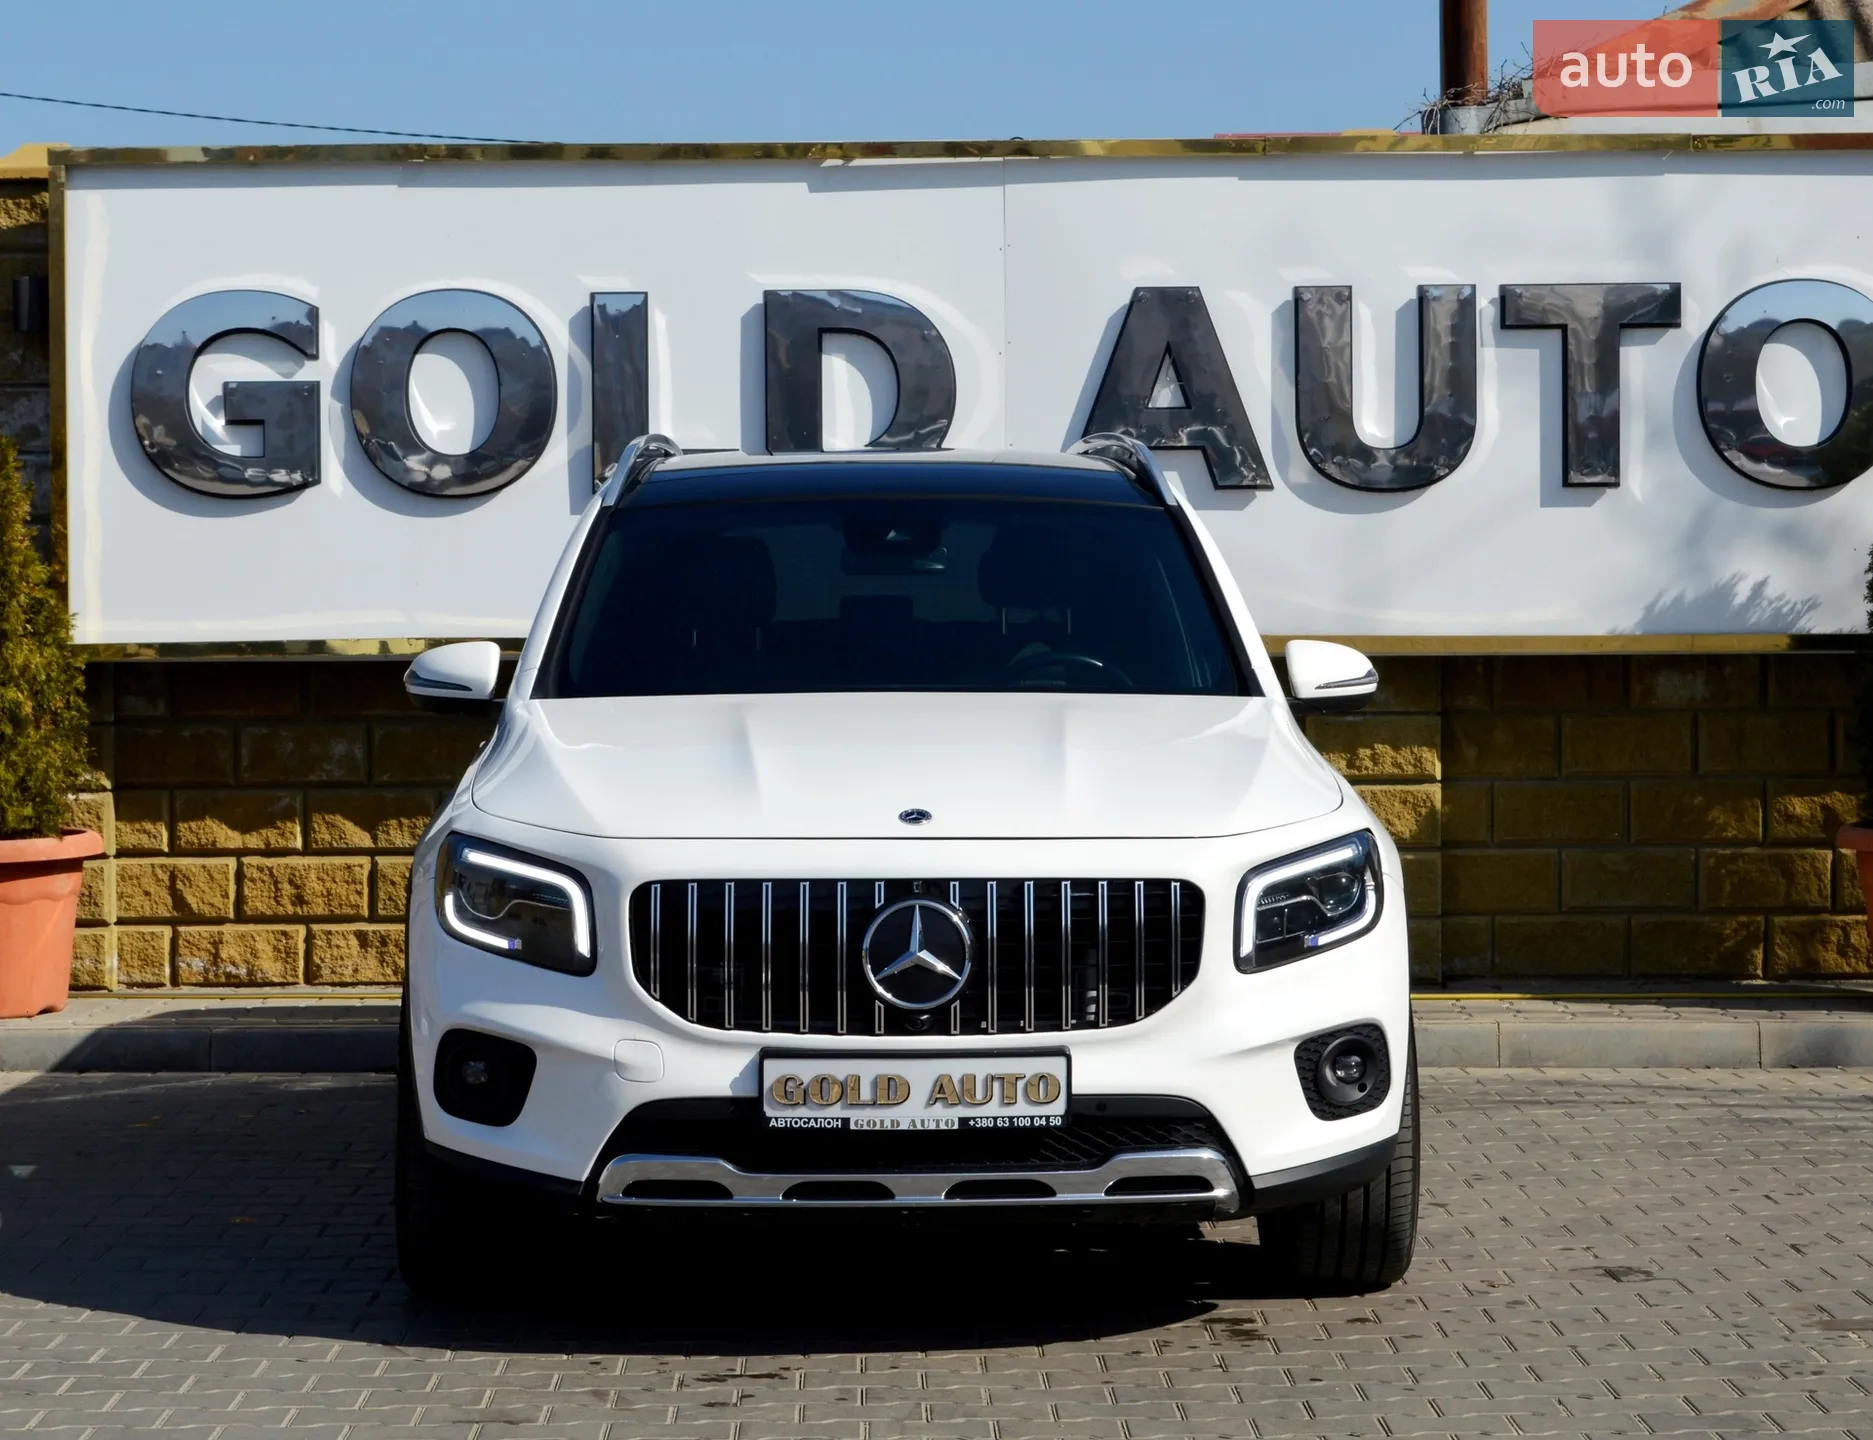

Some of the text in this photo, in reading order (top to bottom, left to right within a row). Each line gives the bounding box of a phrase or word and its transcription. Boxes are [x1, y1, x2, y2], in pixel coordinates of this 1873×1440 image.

[1082, 278, 1873, 492] AUTO
[772, 1072, 1062, 1106] GOLD AUTO
[769, 1118, 842, 1129] АВТОСАЛОН
[853, 1118, 956, 1129] GOLD AUTO
[968, 1116, 1062, 1128] +380 63 100 04 50
